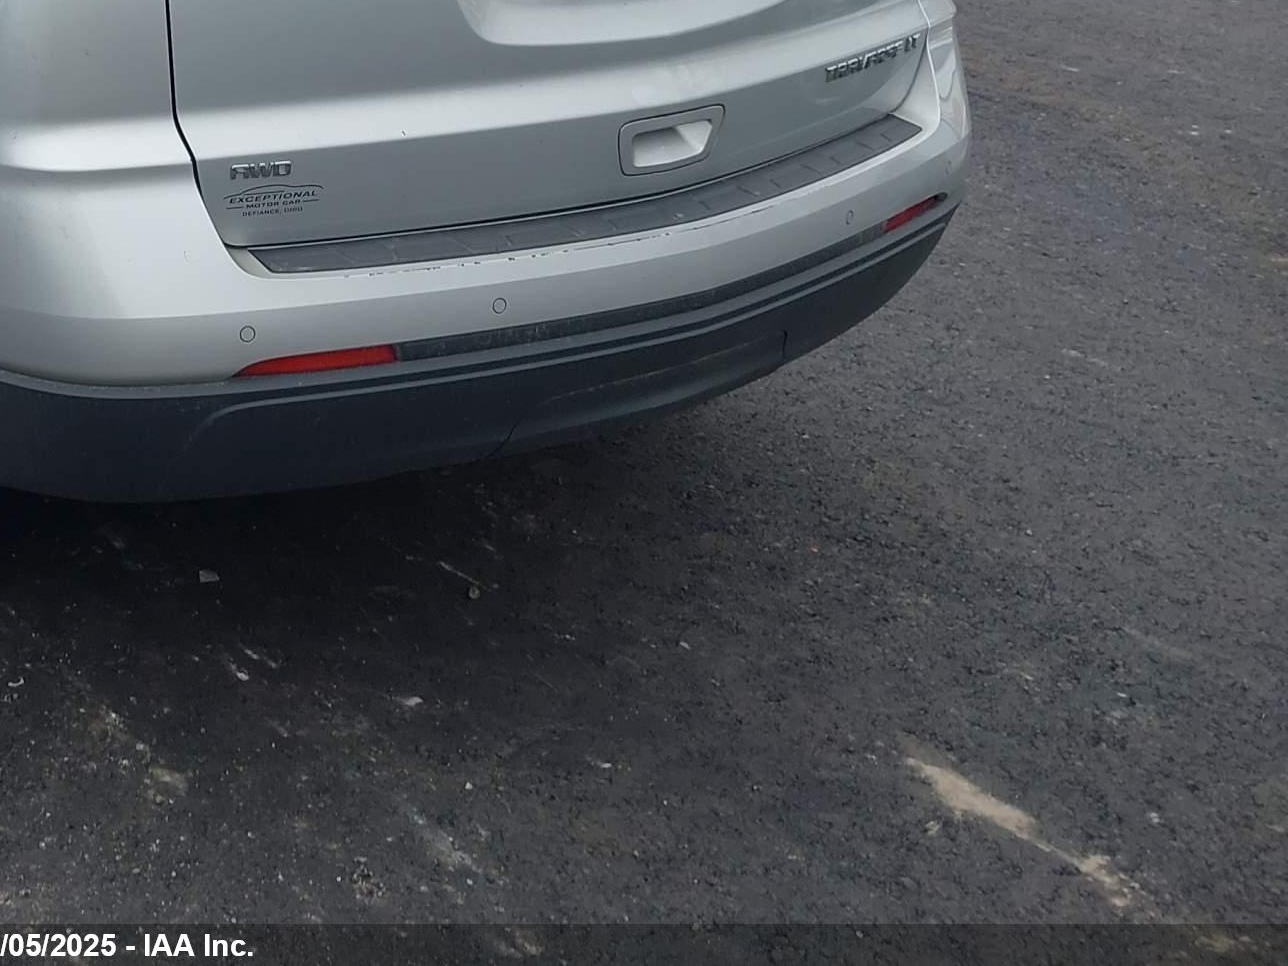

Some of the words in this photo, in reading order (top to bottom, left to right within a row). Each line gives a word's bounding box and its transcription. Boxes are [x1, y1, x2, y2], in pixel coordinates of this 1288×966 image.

[230, 160, 292, 180] AWD
[229, 190, 317, 204] EXCEPTIONAL
[245, 201, 279, 209] MOTOR
